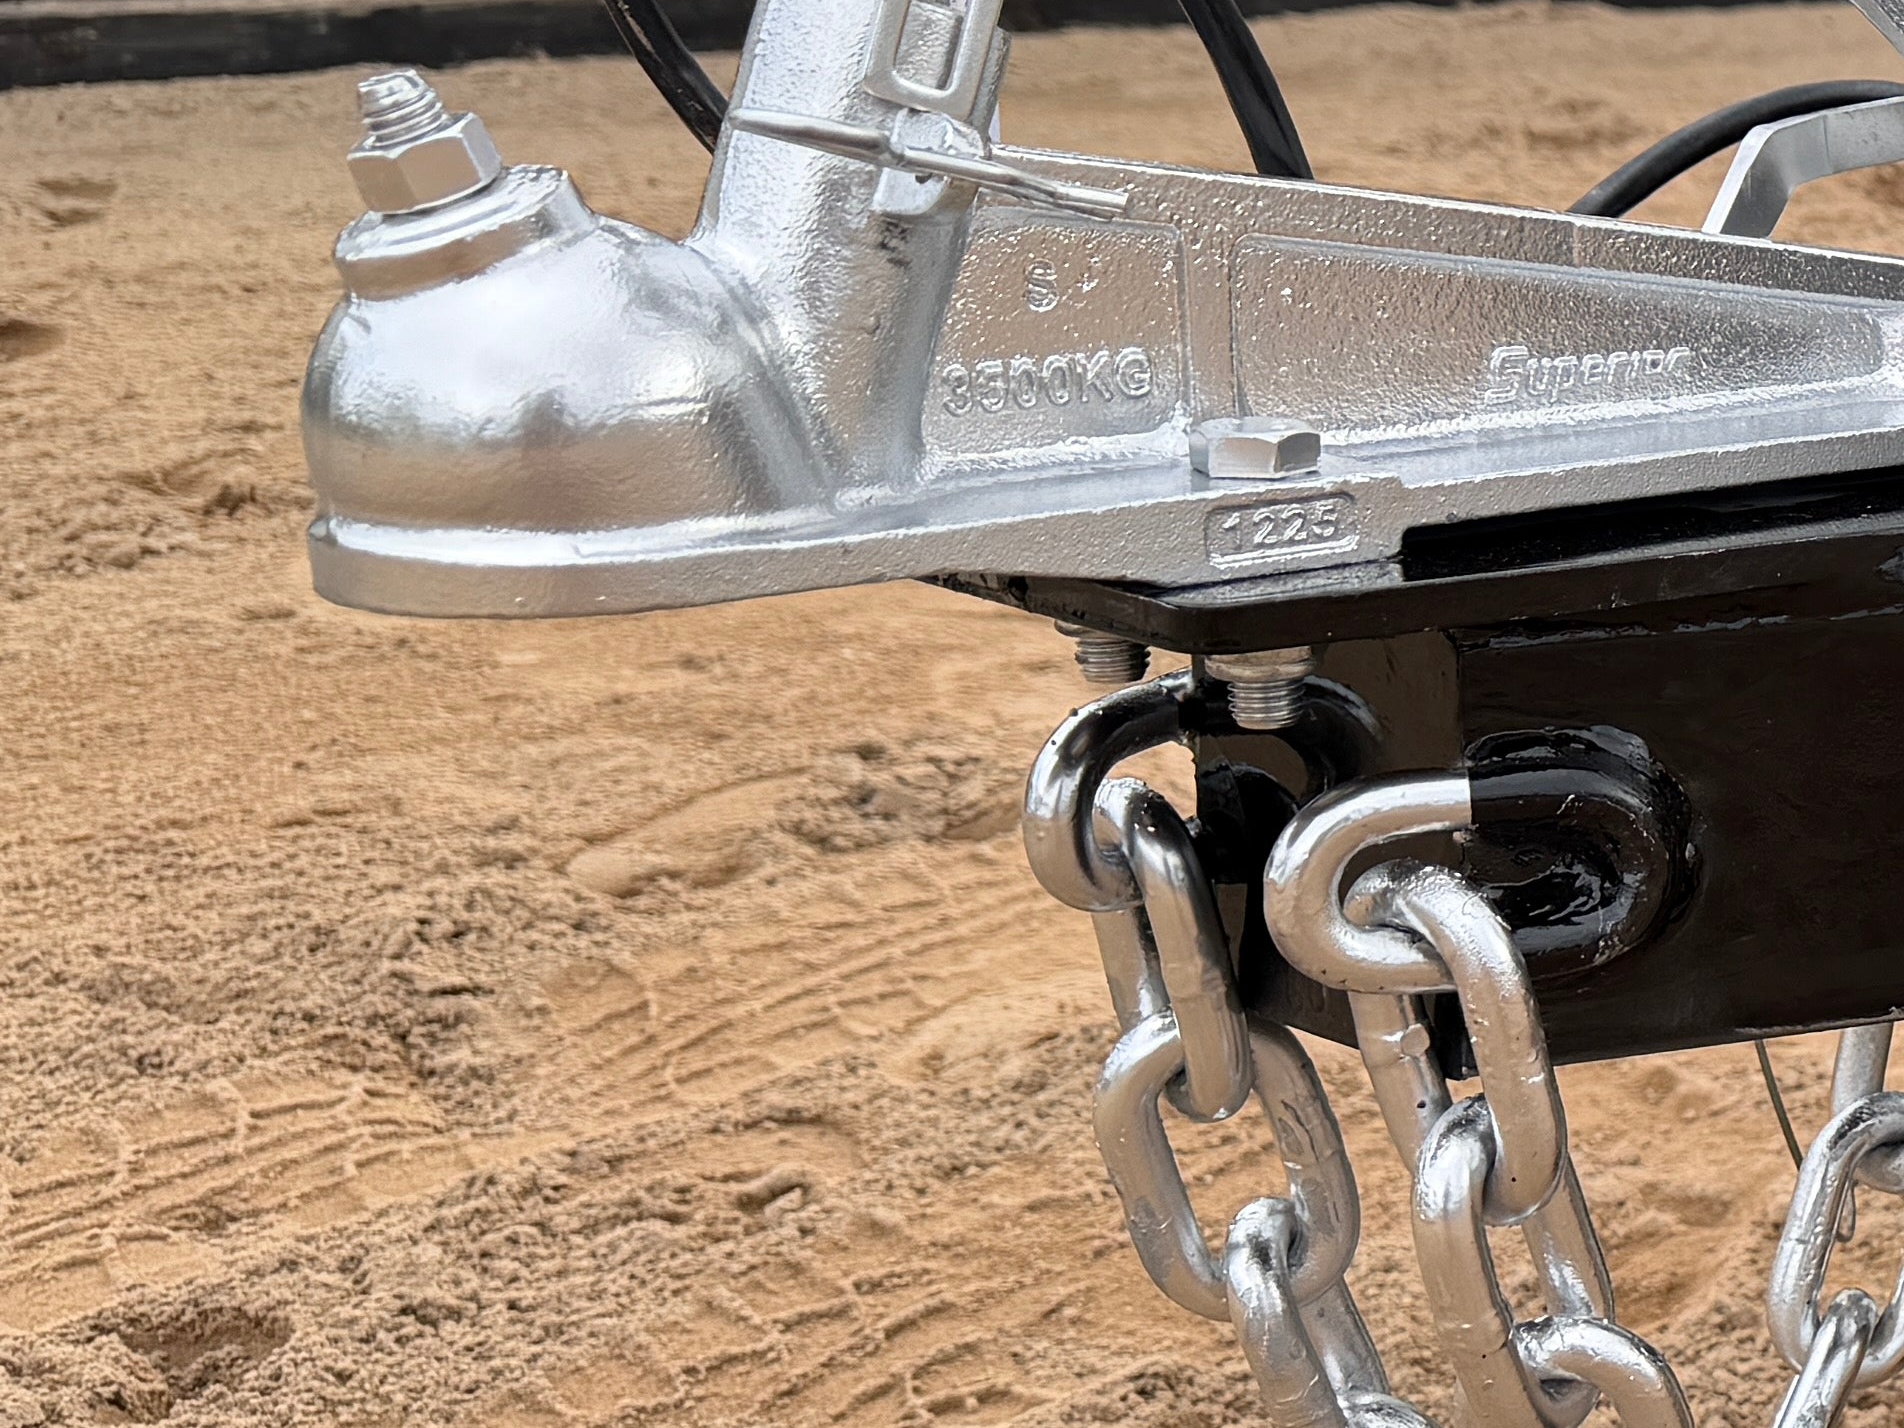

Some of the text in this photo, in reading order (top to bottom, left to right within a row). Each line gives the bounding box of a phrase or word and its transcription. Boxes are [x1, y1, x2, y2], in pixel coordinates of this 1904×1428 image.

[1026, 258, 1060, 313] S
[941, 346, 1153, 417] 3500KG
[1484, 345, 1690, 405] Superior
[1221, 502, 1338, 549] 1225
